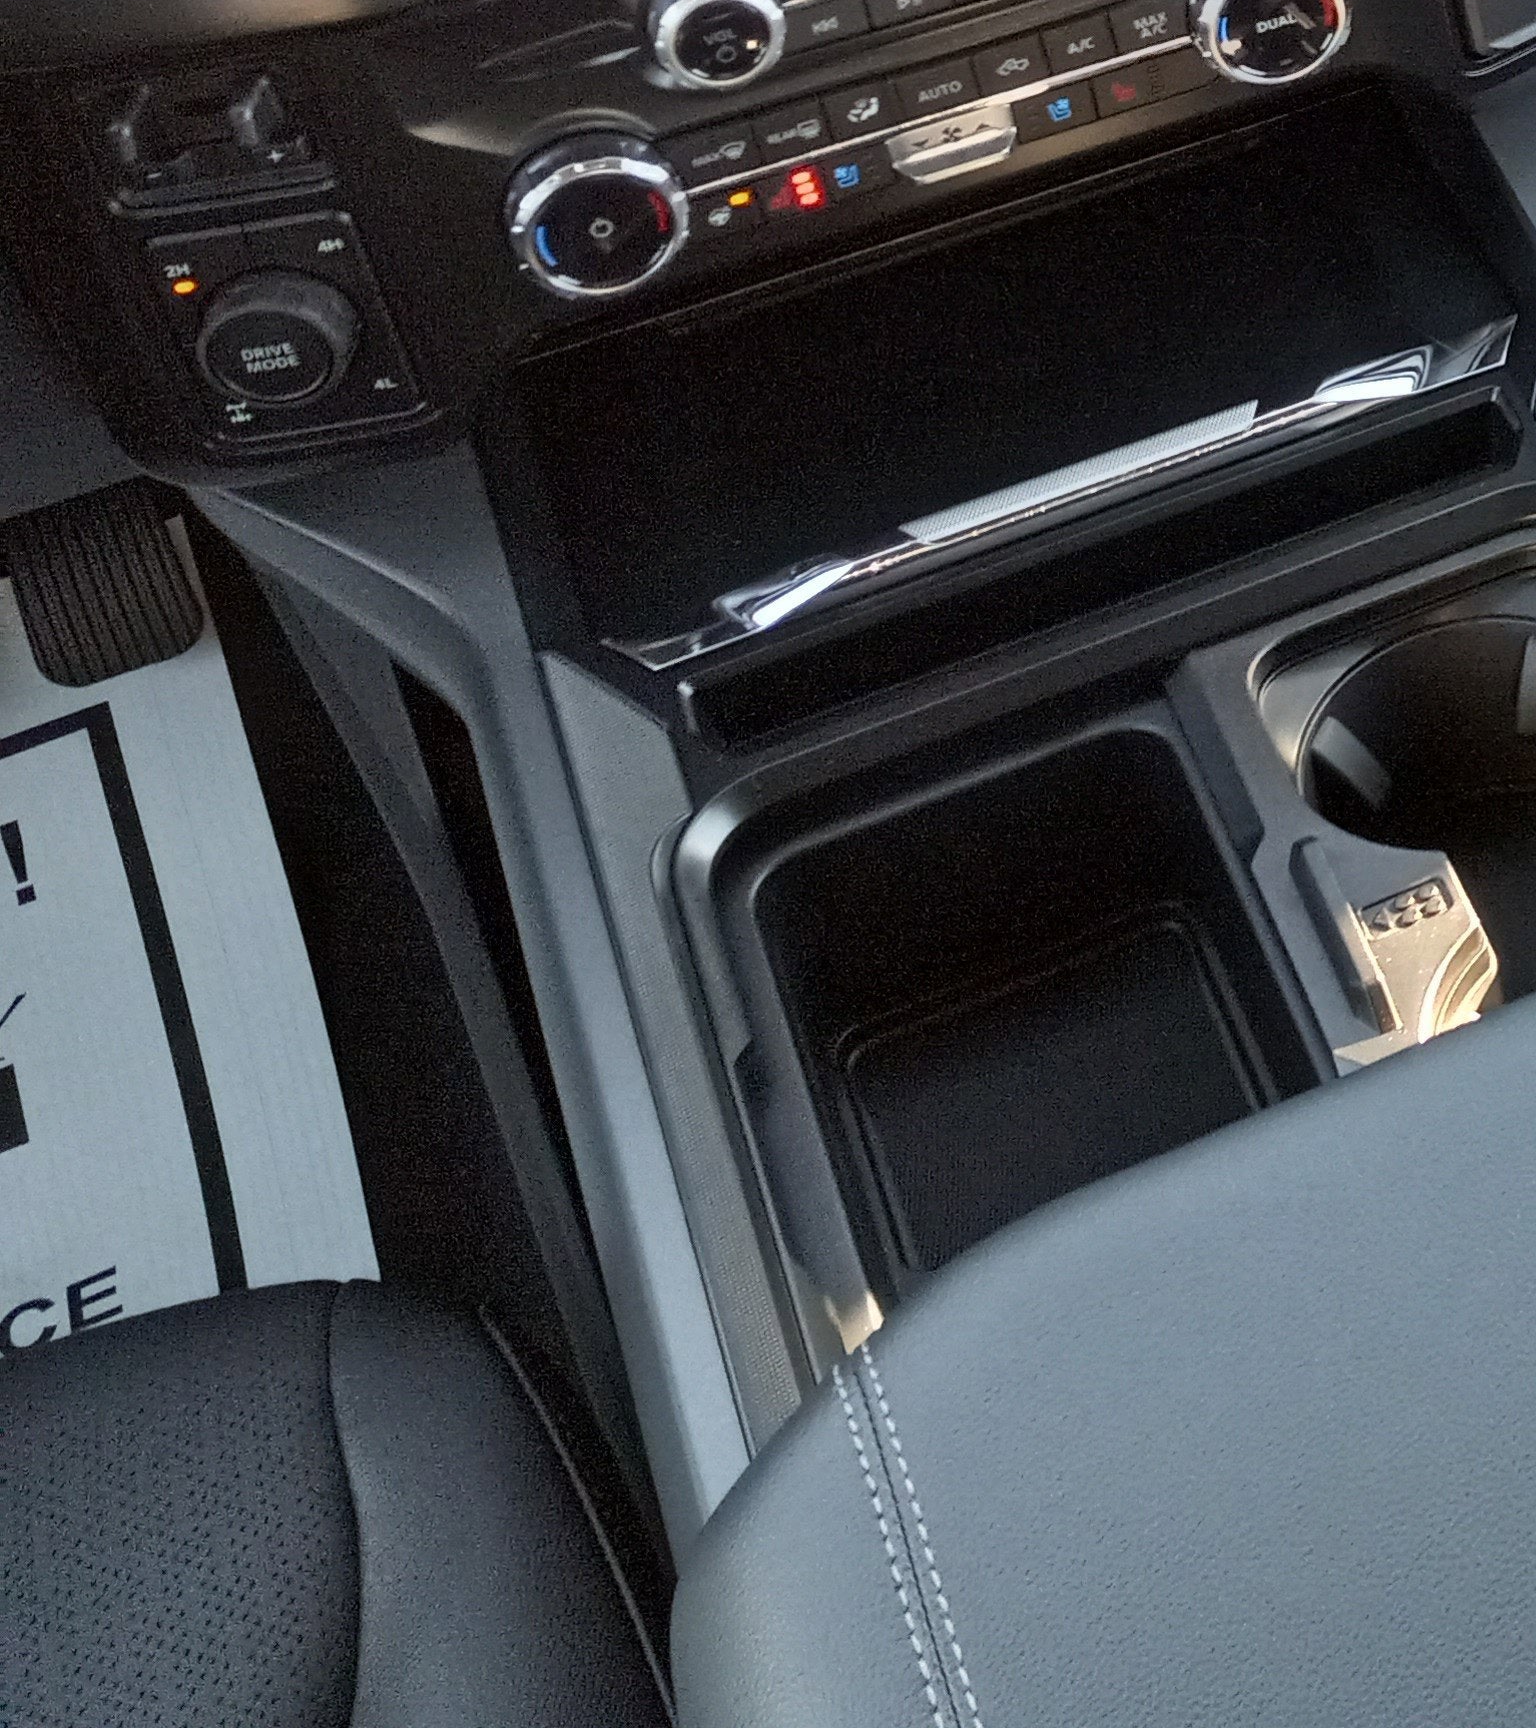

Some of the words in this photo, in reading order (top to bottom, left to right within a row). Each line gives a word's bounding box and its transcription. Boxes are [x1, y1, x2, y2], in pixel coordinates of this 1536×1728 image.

[1133, 11, 1168, 32] MAX
[1140, 22, 1168, 40] A/C
[1255, 12, 1296, 34] DUAL
[1066, 35, 1096, 56] A/C
[918, 79, 963, 103] AUTO
[163, 263, 191, 279] 2H
[240, 341, 296, 362] DRIVE
[246, 355, 299, 373] MODE
[373, 377, 398, 391] 4L
